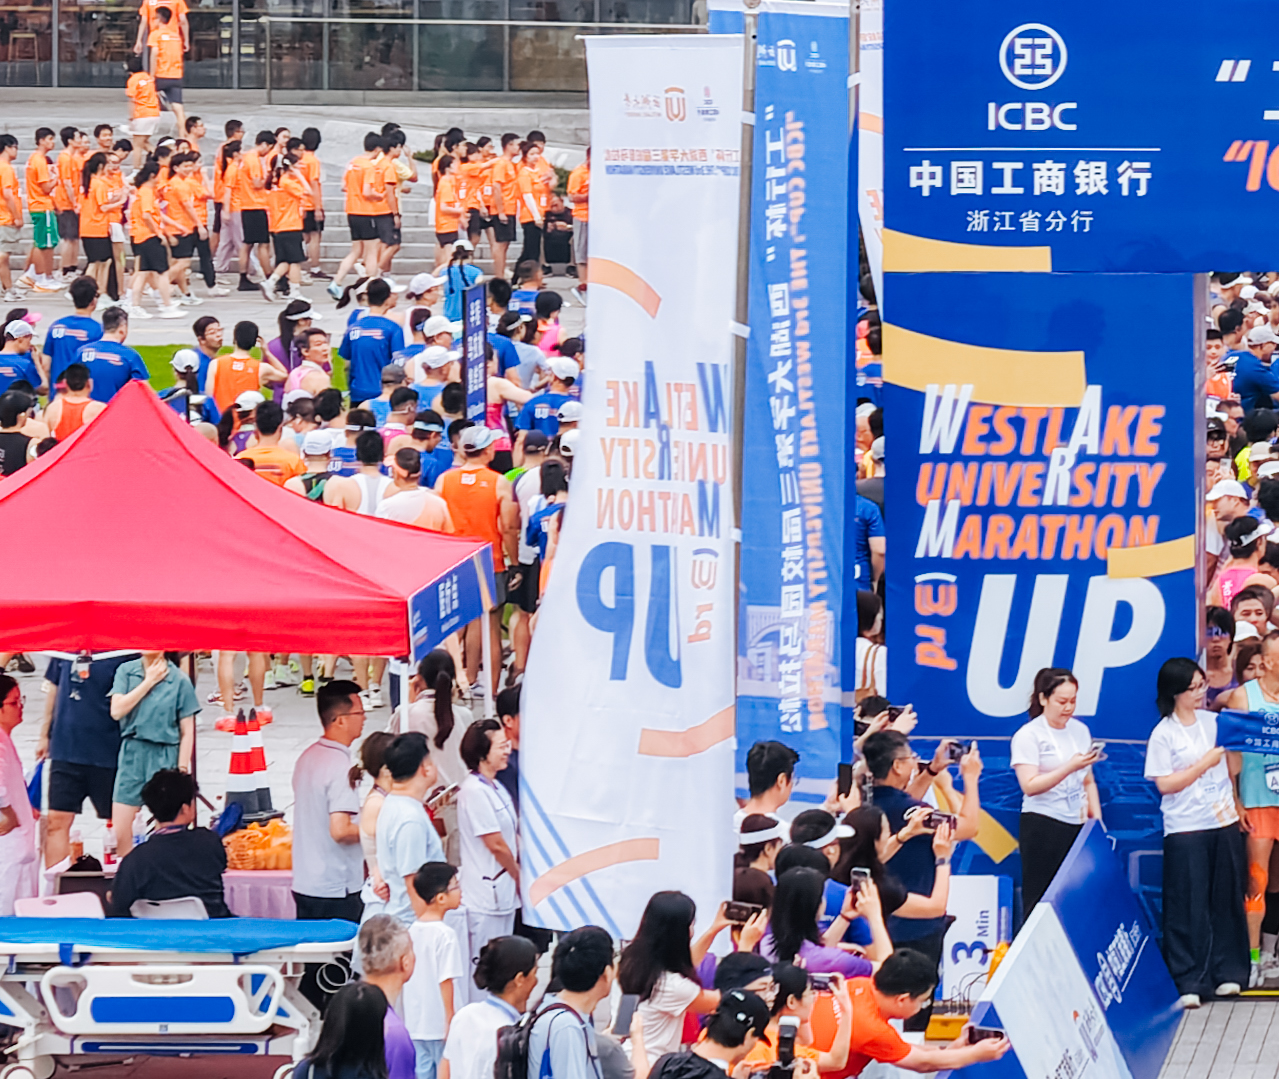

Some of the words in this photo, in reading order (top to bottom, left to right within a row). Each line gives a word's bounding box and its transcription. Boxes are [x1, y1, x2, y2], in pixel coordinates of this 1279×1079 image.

[987, 101, 1079, 132] ICBC
[909, 159, 1153, 198] 中国工商银行
[966, 208, 1094, 234] 浙江省分行
[919, 384, 1166, 457] WESTLAKE
[916, 447, 1166, 508] UNIVERSITY
[915, 499, 1161, 561] MARATHON
[966, 573, 1166, 718] UP
[1271, 776, 1279, 788] A
[951, 940, 988, 967] 3
[976, 909, 990, 937] Min
